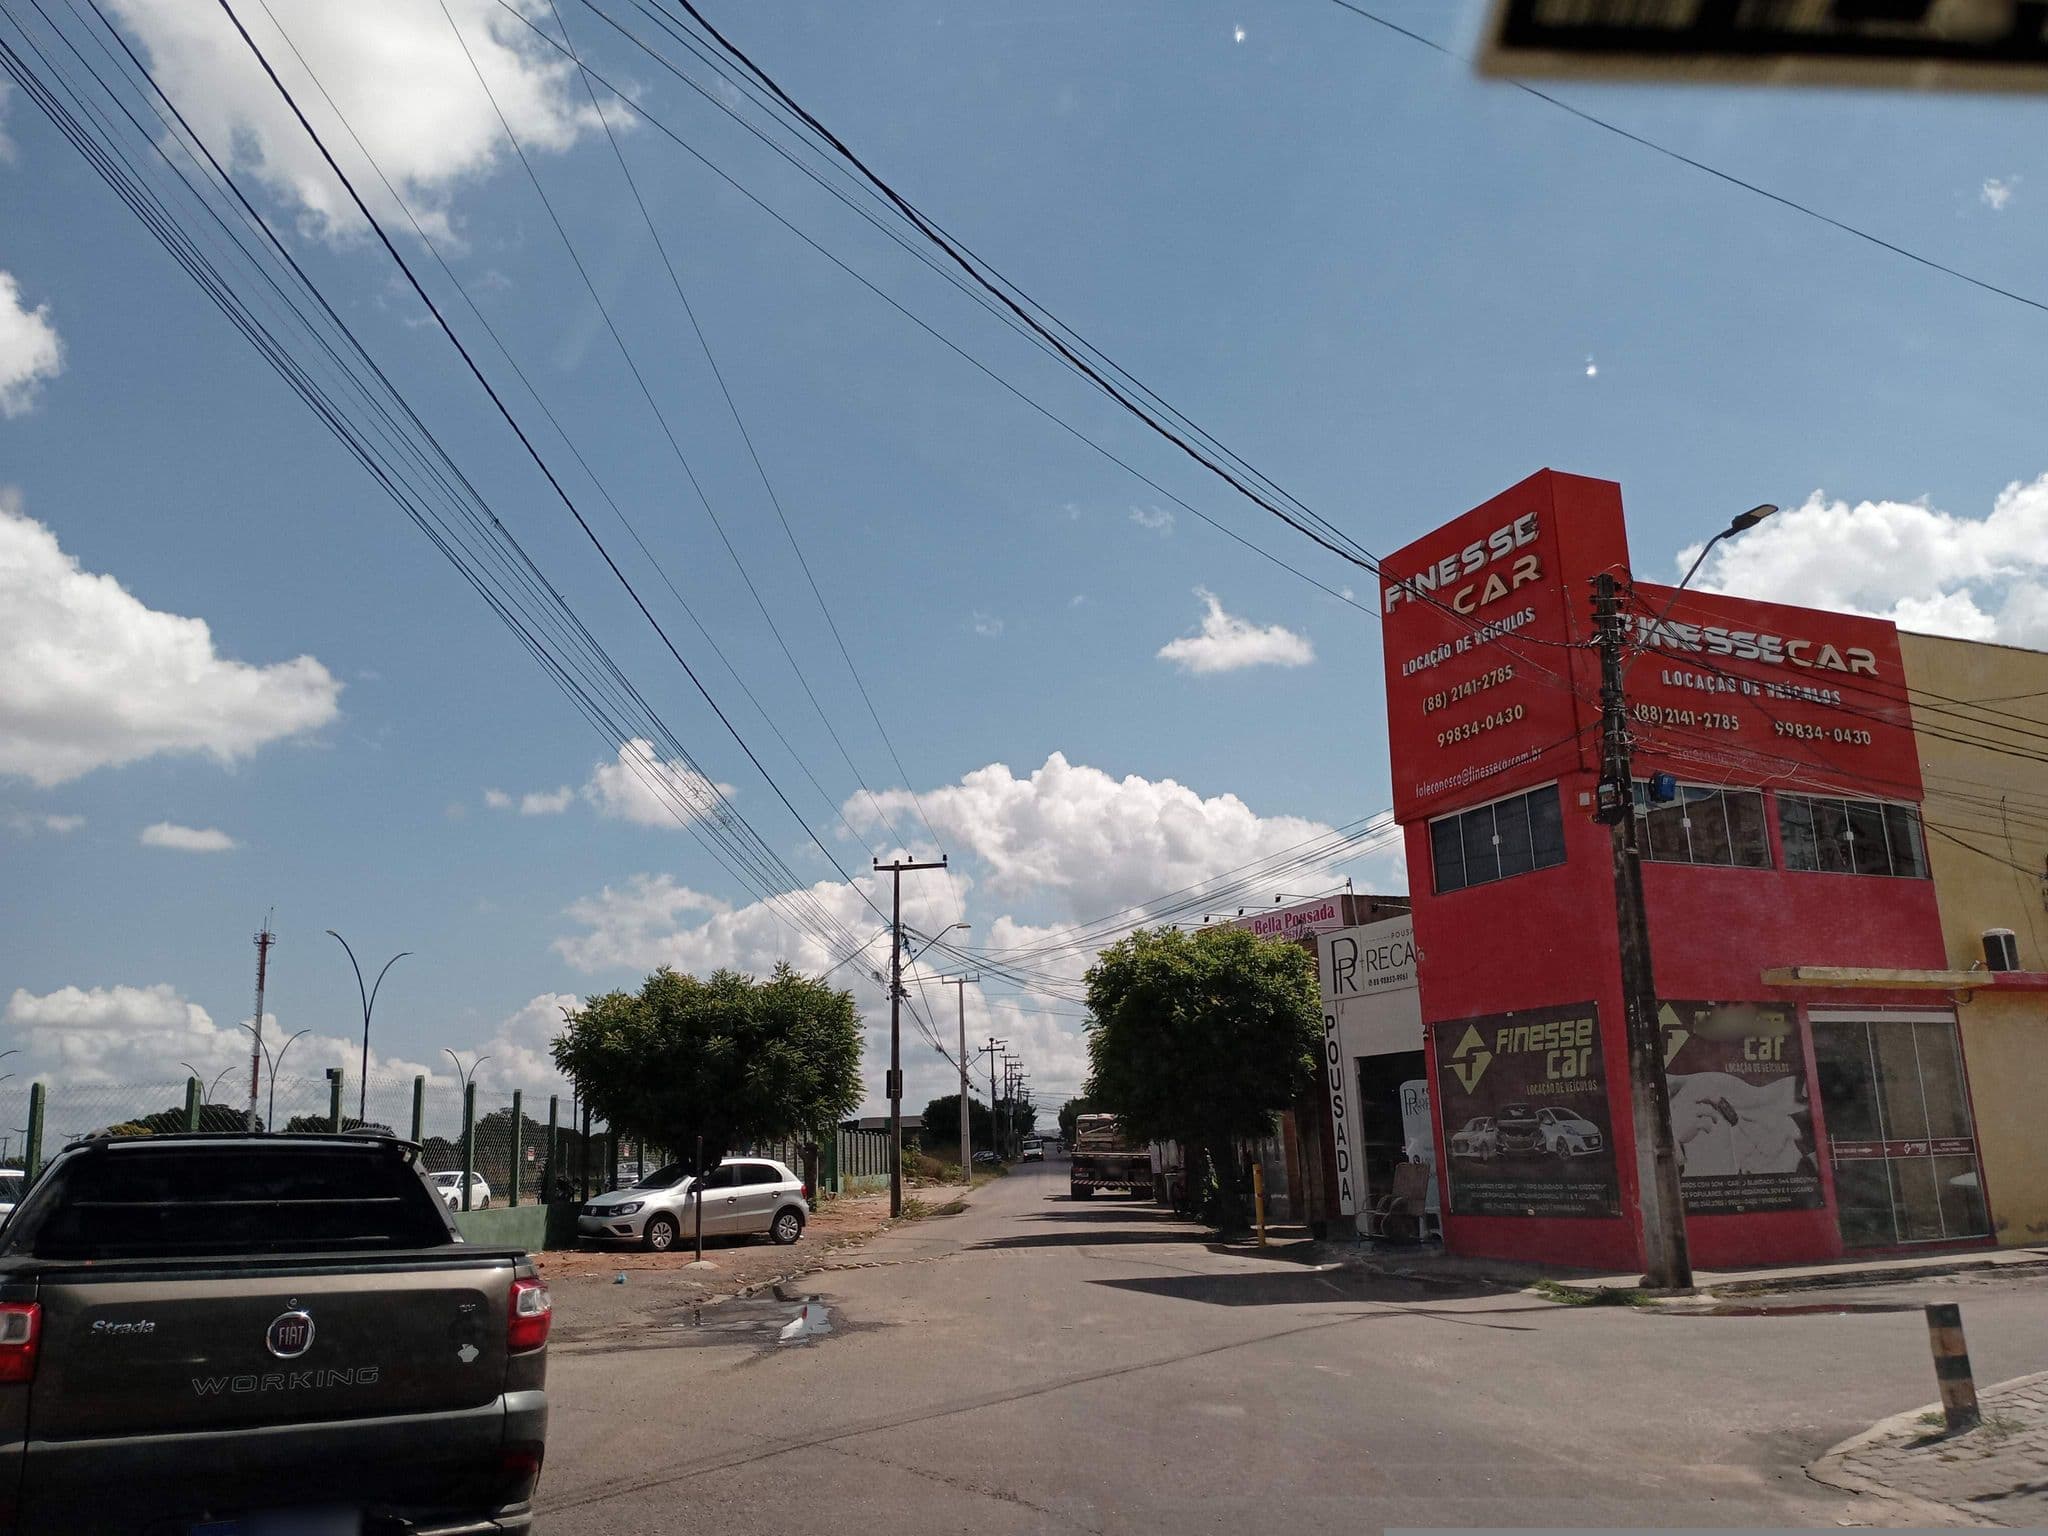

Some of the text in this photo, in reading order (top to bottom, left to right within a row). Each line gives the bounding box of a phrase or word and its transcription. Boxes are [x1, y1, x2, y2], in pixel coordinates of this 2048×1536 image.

[1384, 511, 1538, 613] FINESSE
[1452, 554, 1541, 615] CAR
[1402, 643, 1452, 678] LOCAÇÃO
[1456, 633, 1472, 654] DE
[1422, 664, 1513, 716] (88) 2141-2785
[1743, 679, 1760, 697] DE
[1438, 704, 1524, 748] 99834-0430
[1636, 702, 1740, 731] (88) 2141-2785
[1775, 720, 1871, 745] 99834-0430
[1254, 916, 1282, 935] Bella
[1284, 903, 1336, 929] Pousada
[1324, 1014, 1352, 1202] POUSADA
[90, 1319, 156, 1335] Strada
[278, 1325, 305, 1346] FIAT
[191, 1366, 379, 1397] WORKING
